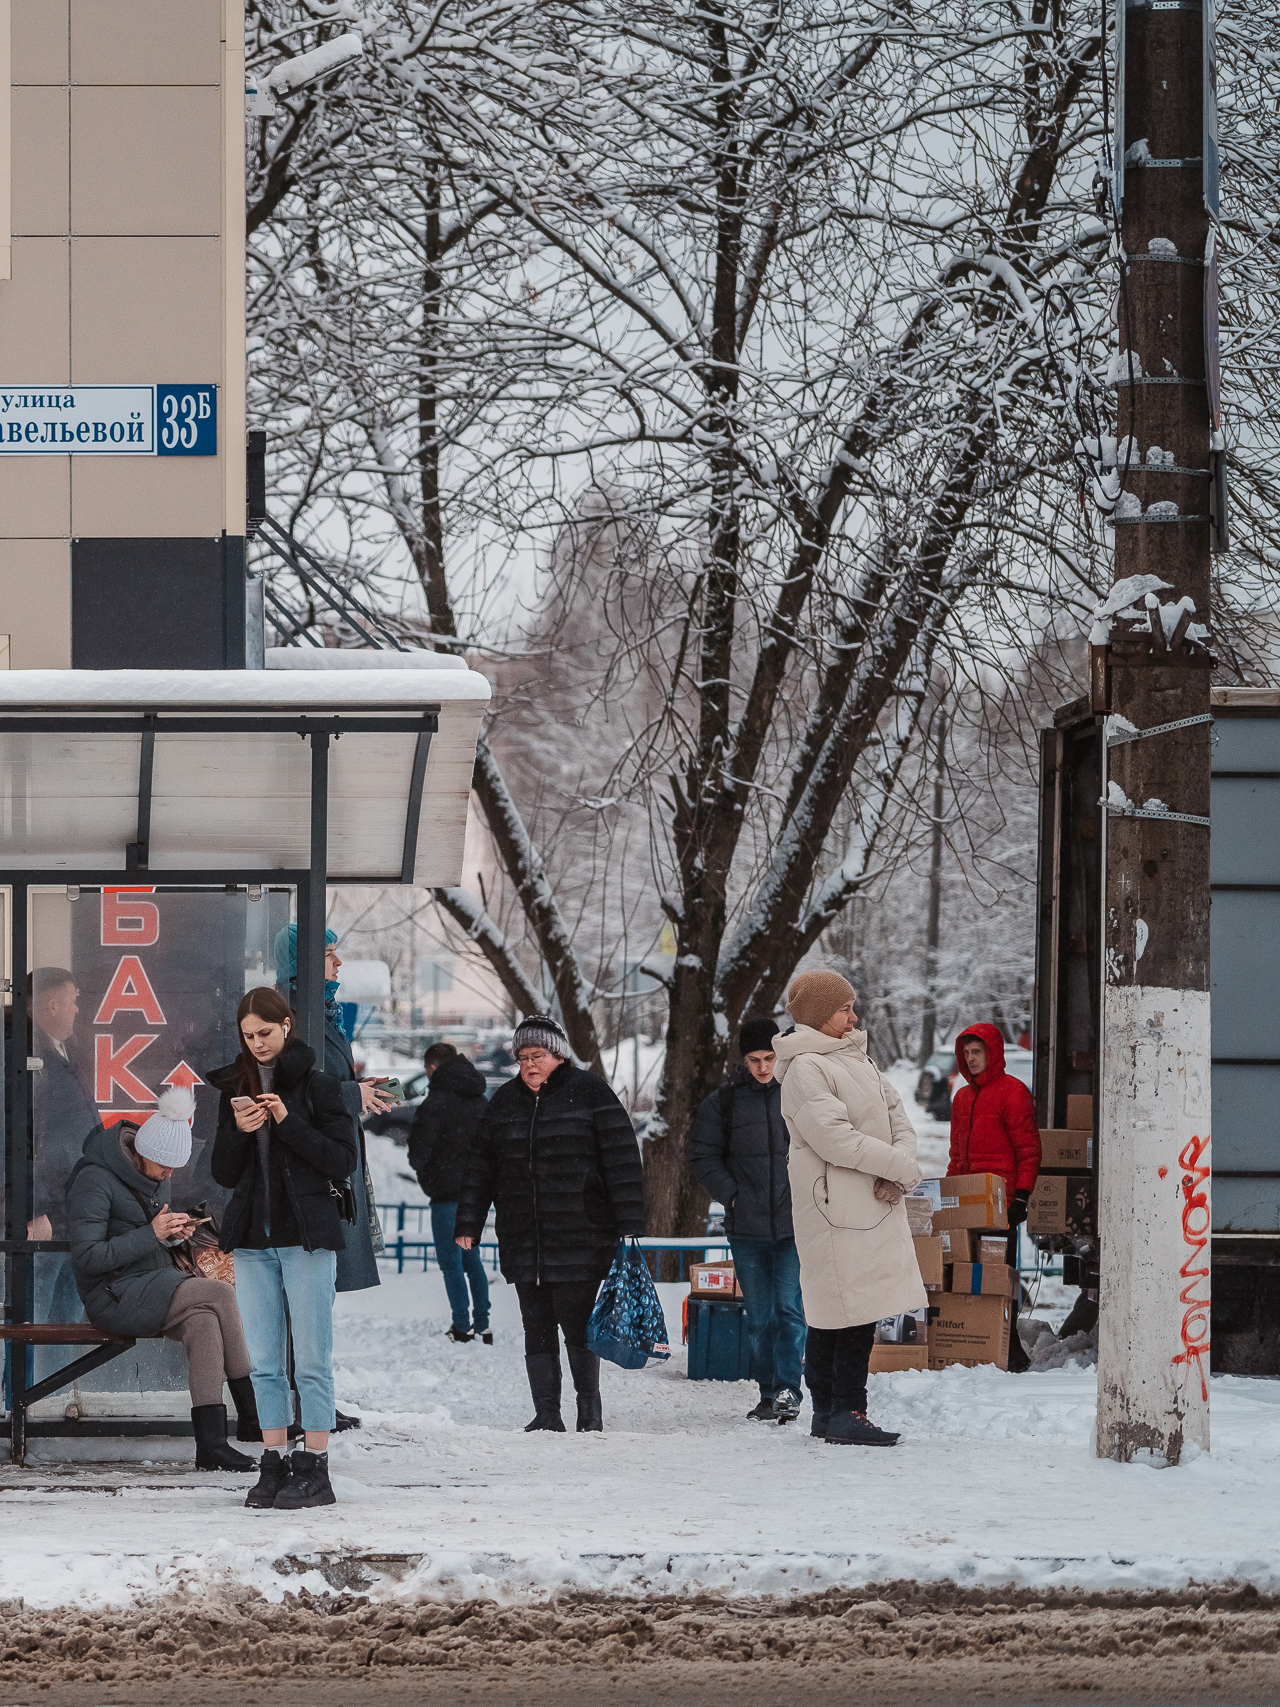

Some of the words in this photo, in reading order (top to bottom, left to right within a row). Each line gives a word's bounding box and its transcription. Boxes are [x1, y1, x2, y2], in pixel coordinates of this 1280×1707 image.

[1, 394, 76, 413] улица
[161, 392, 211, 449] 33Б
[936, 1319, 965, 1330] Kitfort
